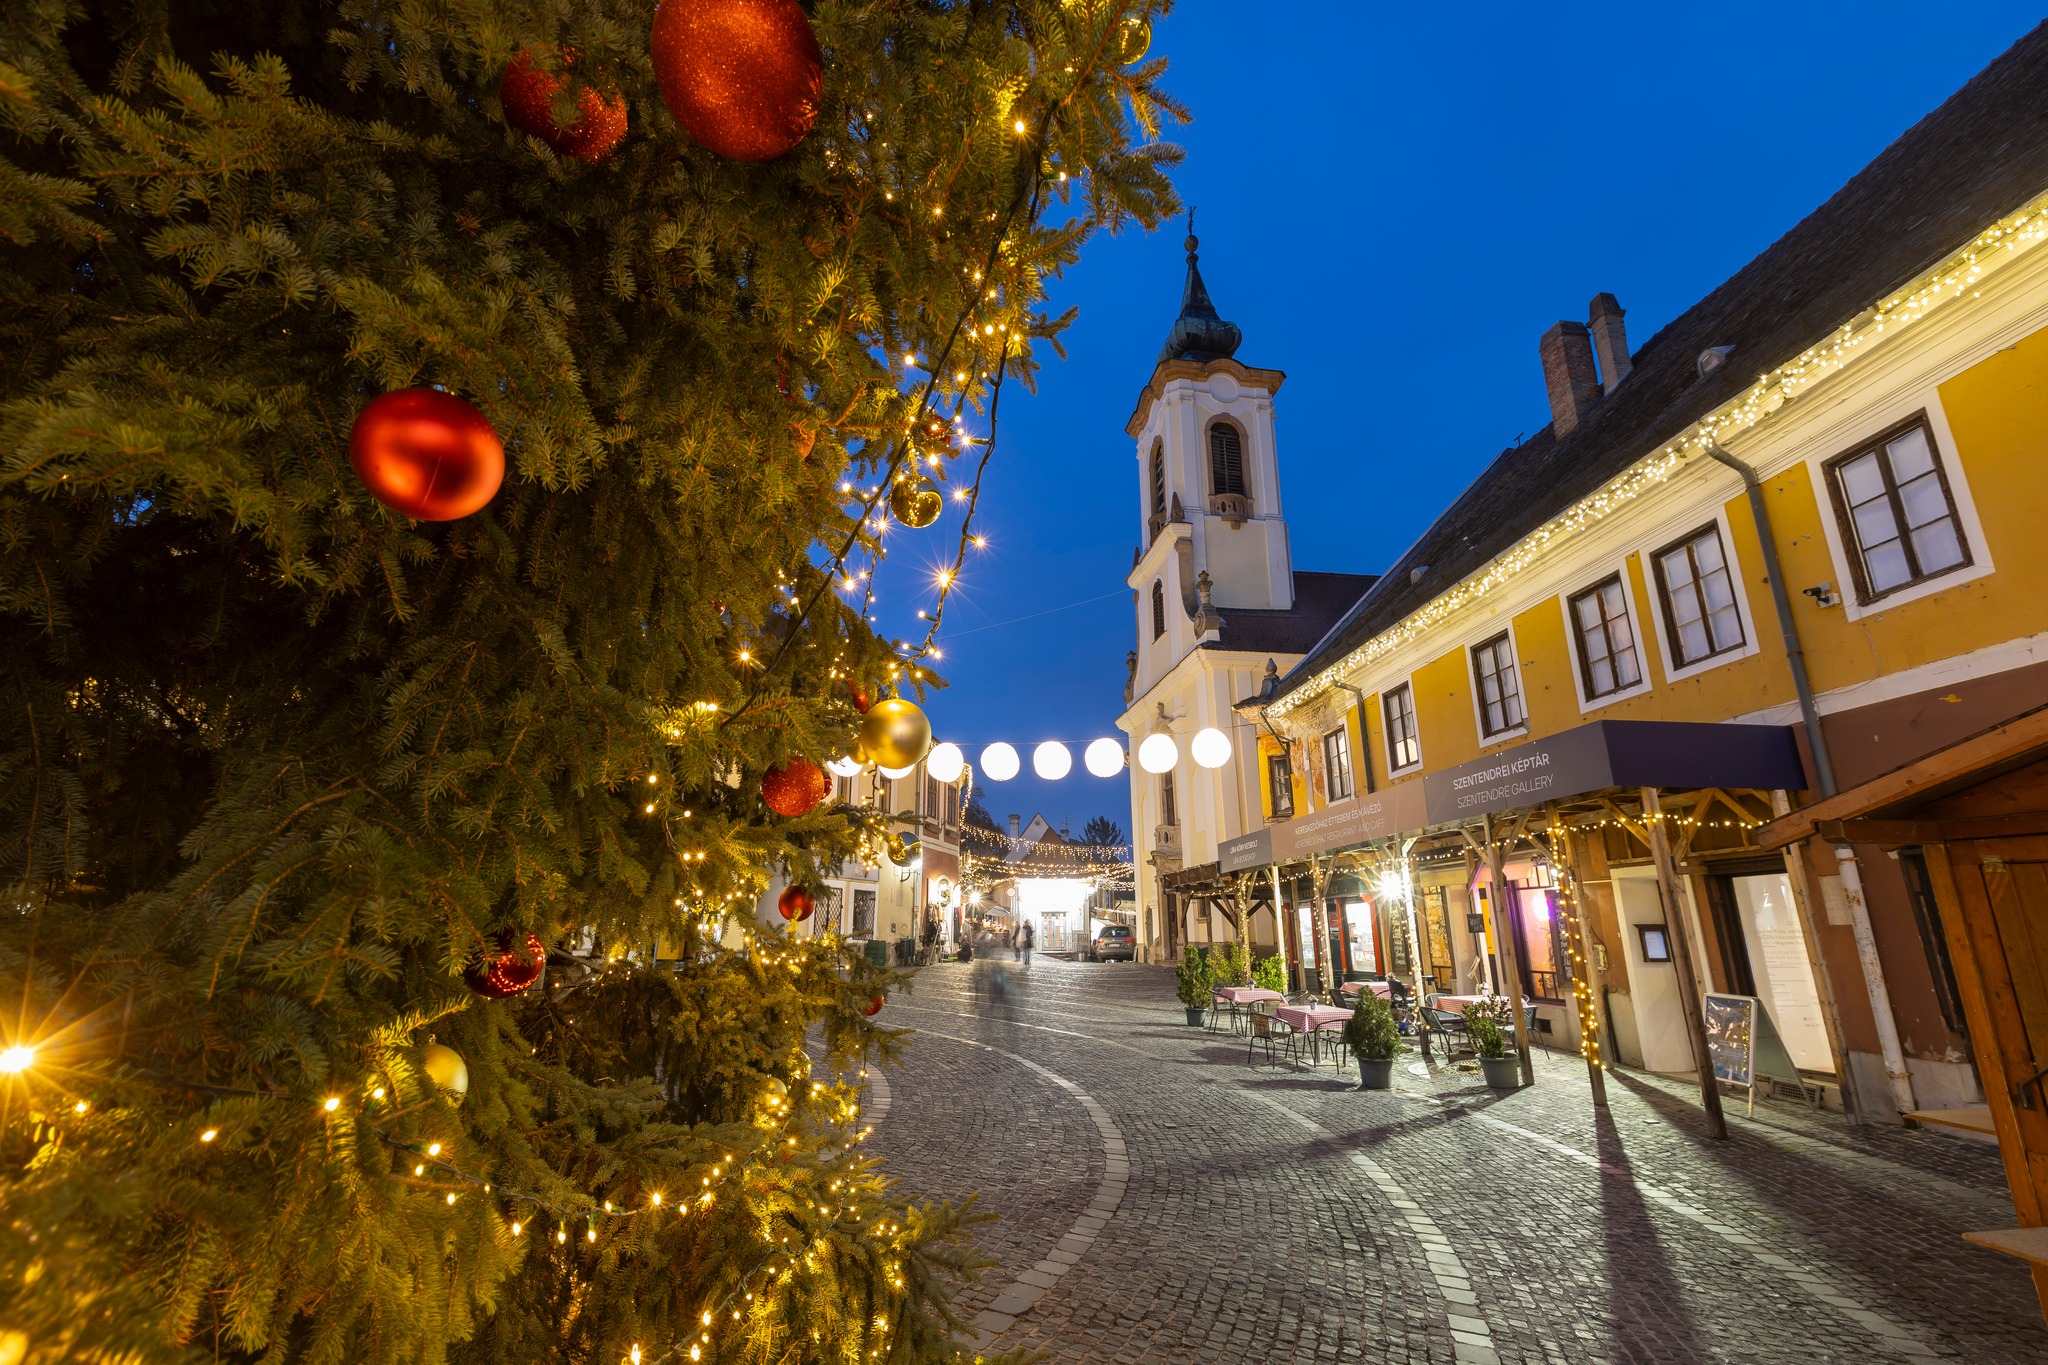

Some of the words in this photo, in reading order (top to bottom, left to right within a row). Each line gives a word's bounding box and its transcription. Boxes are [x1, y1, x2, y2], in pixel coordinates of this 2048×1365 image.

[1453, 765, 1511, 790] SZENTENDREI
[1511, 752, 1550, 774] KÉPTÁR
[1457, 785, 1510, 808] SZENTENDRE
[1511, 774, 1554, 796] GALLERY
[1328, 811, 1351, 825] ÉTTEREM
[1351, 807, 1359, 820] ÉS
[1359, 800, 1382, 818] KÁVÉZÓ
[1327, 825, 1358, 841] RESTAURANT
[1358, 821, 1371, 833] AND
[1370, 815, 1386, 830] CAFÉ
